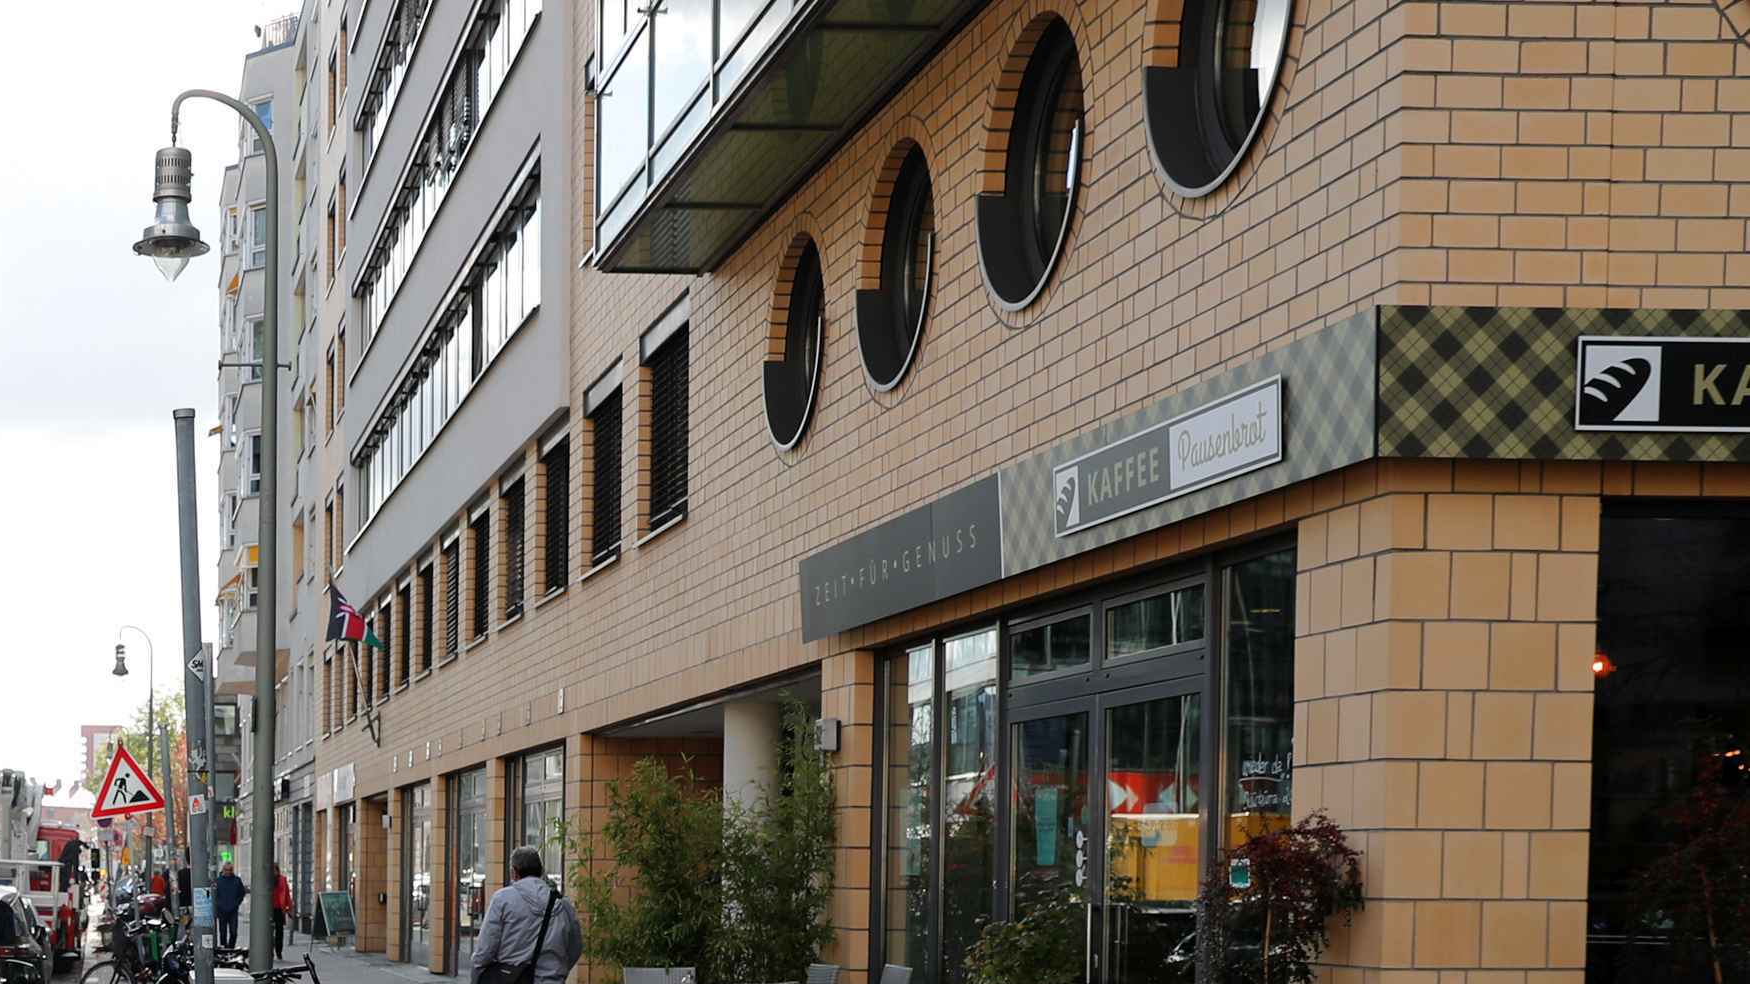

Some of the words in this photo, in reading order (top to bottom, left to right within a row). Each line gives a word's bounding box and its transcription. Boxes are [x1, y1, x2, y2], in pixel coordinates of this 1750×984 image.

[1177, 399, 1267, 472] Pausenbrot
[1087, 447, 1160, 506] KAFFEE
[902, 523, 978, 573] GENUSS
